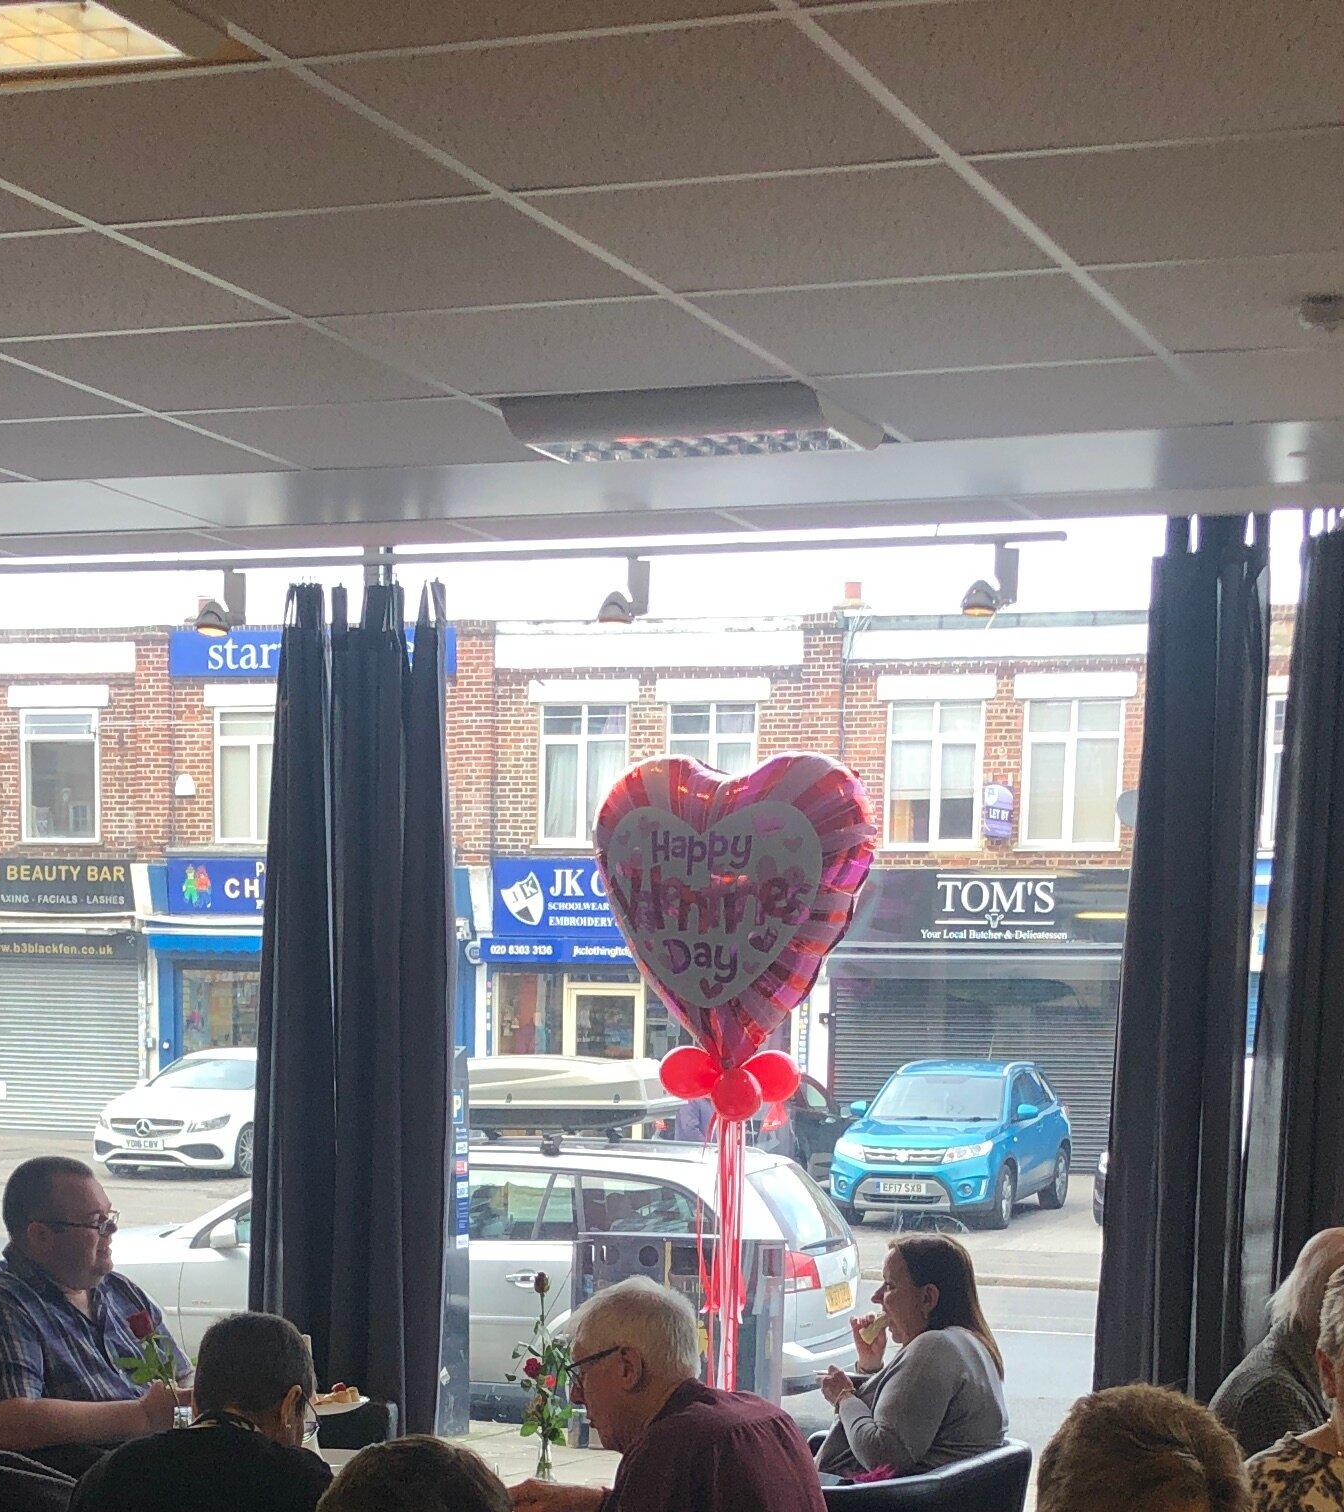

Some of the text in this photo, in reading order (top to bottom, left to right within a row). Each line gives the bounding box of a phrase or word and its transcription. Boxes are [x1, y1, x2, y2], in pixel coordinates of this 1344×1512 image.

[651, 830, 753, 876] Happy
[6, 864, 81, 883] BEAUTY
[87, 865, 125, 883] BAR
[549, 869, 585, 897] JK
[37, 894, 78, 905] FACIALS
[86, 895, 125, 905] LASHES
[937, 880, 1055, 914] TOM'S
[547, 902, 610, 911] SCHOOLWEAR
[548, 916, 613, 928] EMBROIDERY
[921, 929, 1068, 940] Your Local Butcher & Delicatessen
[490, 944, 507, 956] 020
[532, 945, 553, 956] 3136
[663, 938, 738, 984] Day
